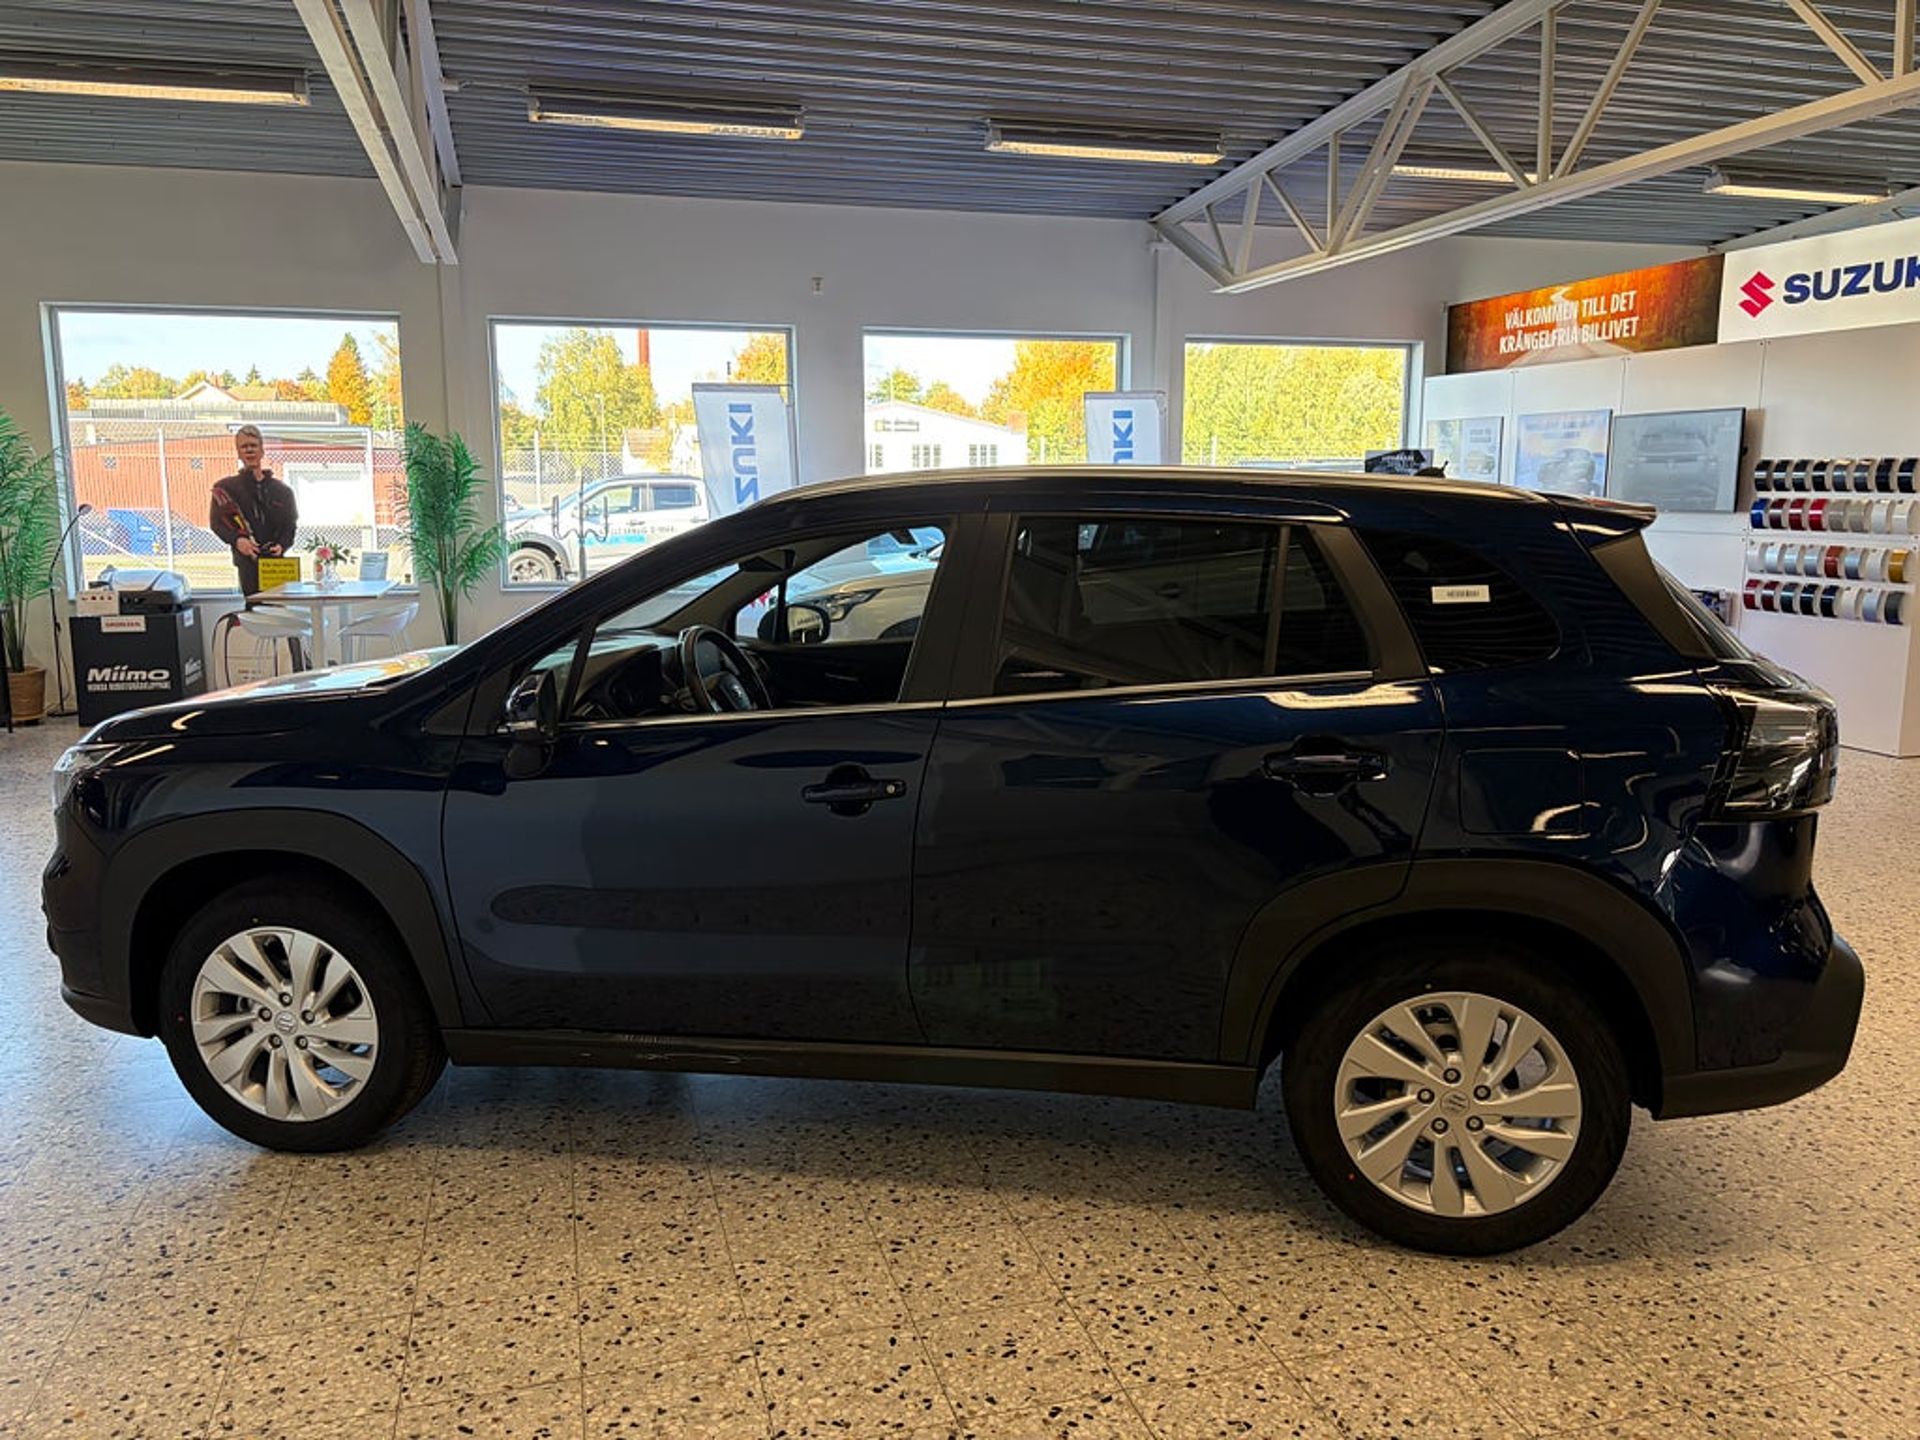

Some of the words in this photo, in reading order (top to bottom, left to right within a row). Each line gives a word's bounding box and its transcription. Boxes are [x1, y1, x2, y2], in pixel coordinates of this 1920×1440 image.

[1504, 299, 1578, 329] VÄLKOMMEN
[1582, 295, 1607, 317] TILL
[1610, 290, 1637, 313] DET
[1581, 316, 1640, 342] BILLIVET
[87, 664, 170, 682] Miimo
